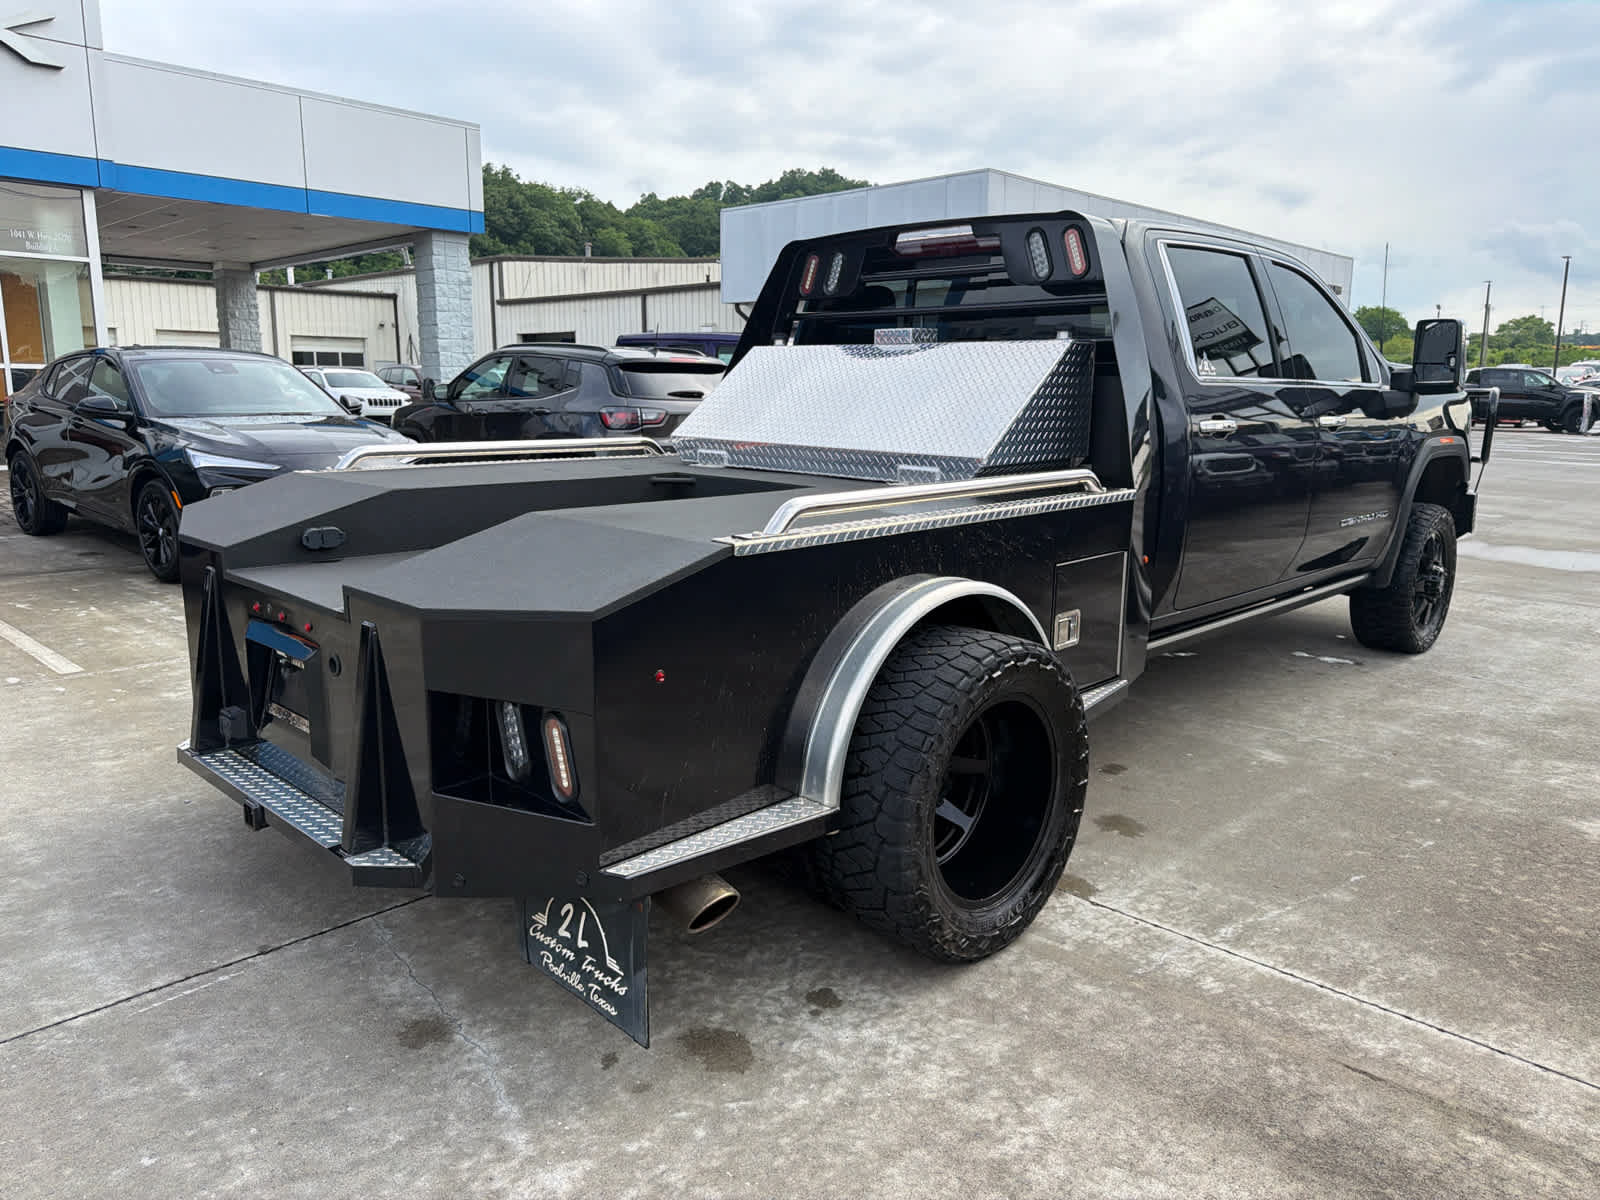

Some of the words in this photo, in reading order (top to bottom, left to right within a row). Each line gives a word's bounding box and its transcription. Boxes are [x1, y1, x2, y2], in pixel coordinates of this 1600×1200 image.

[529, 923, 575, 961] Custom
[581, 955, 628, 996] Trucks
[588, 983, 618, 1016] Texas
